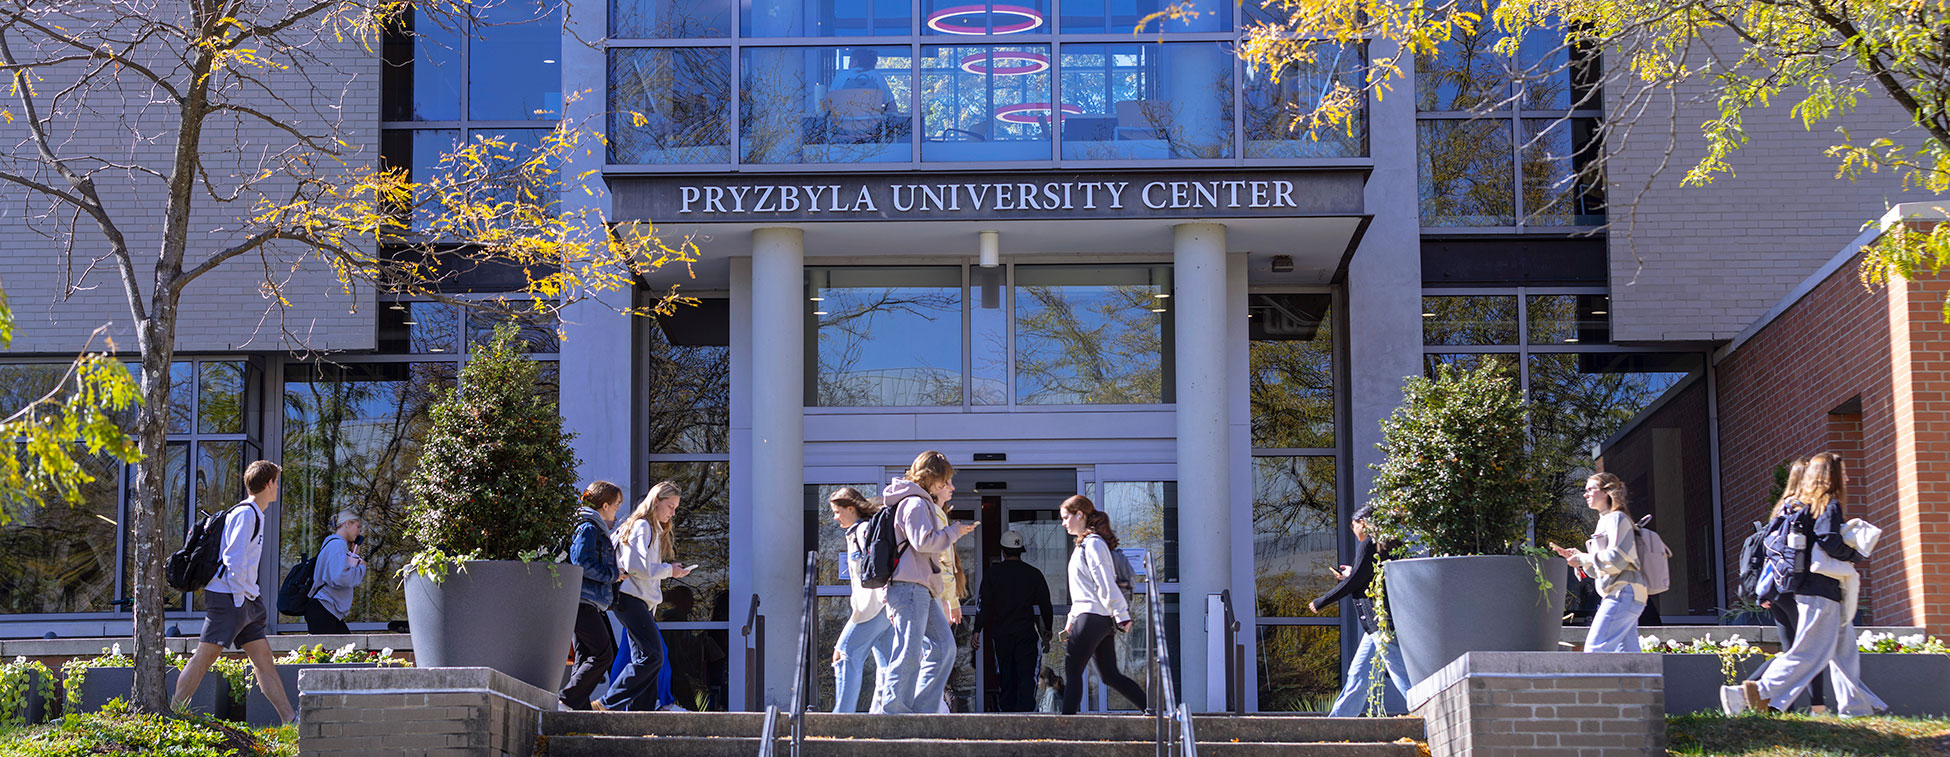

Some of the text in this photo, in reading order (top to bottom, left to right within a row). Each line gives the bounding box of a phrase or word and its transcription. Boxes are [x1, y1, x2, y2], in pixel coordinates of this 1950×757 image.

[679, 180, 1298, 213] PRYZBYLA UNIVERSITY CENTER
